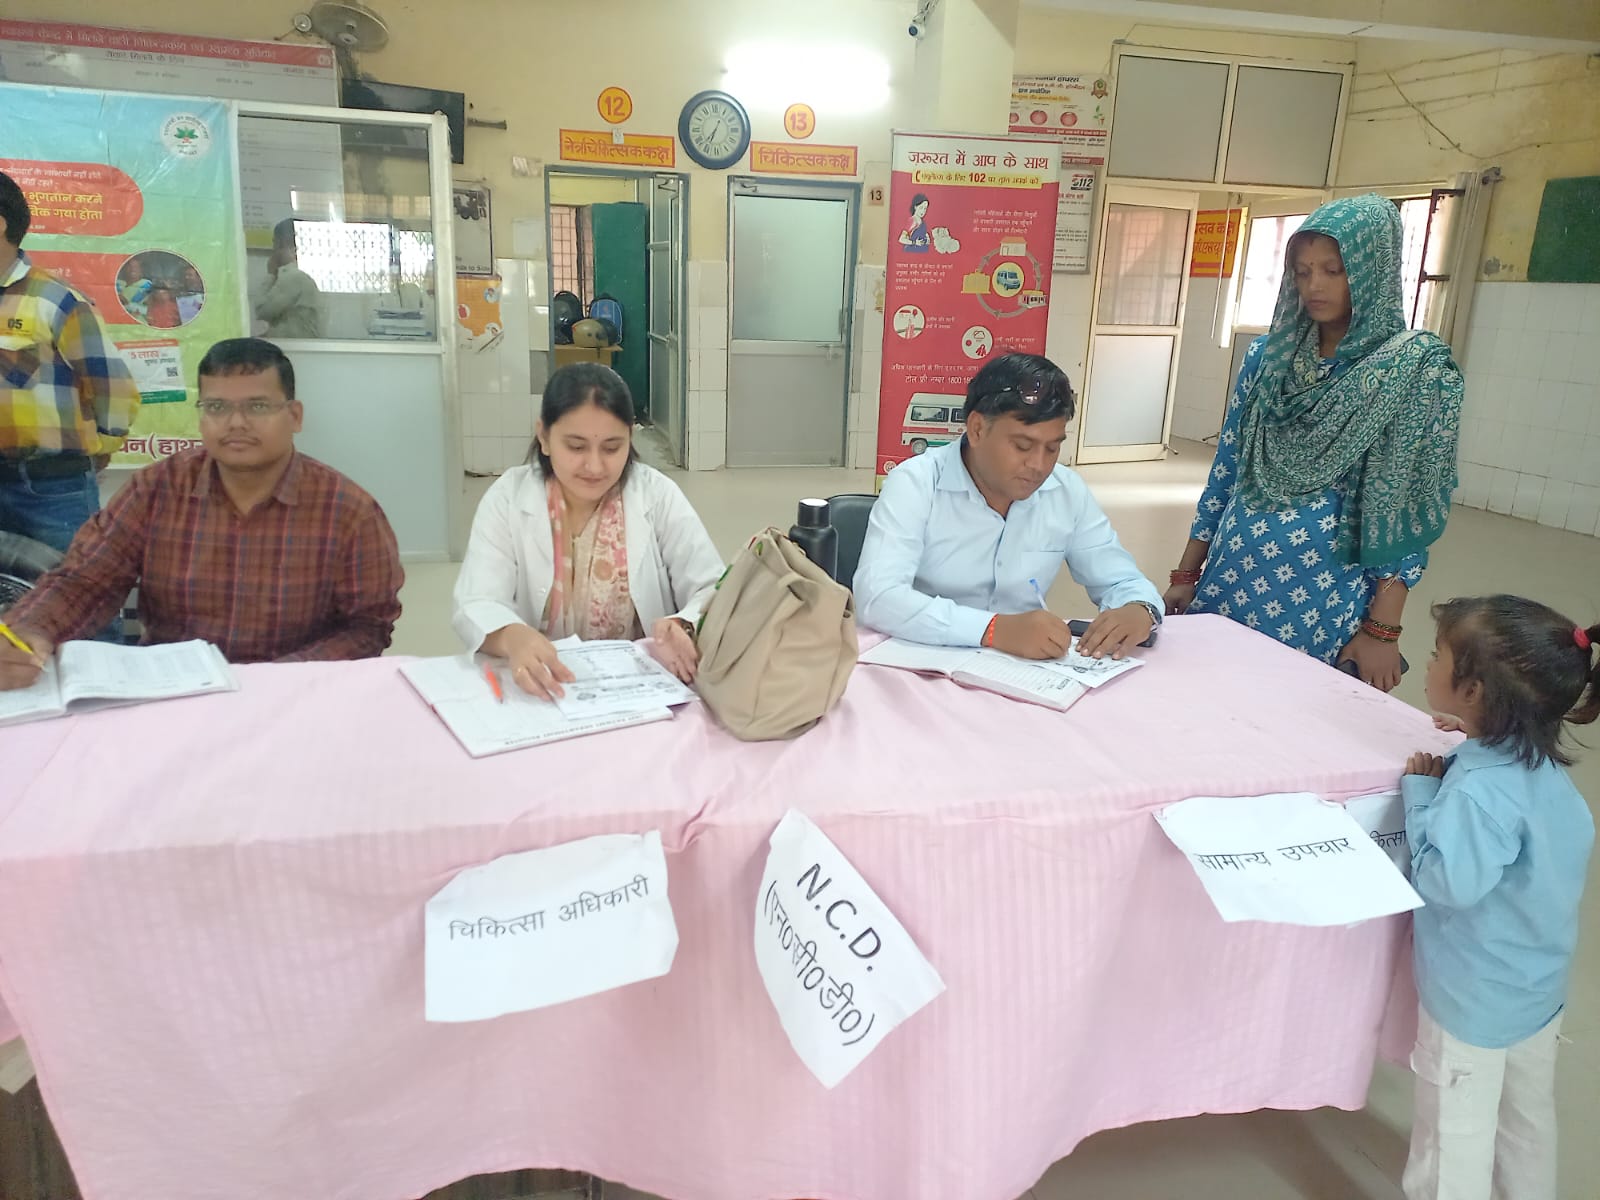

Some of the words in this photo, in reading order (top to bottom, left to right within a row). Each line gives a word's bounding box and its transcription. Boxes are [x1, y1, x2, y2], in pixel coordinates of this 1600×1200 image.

[602, 96, 625, 117] 12
[790, 111, 808, 132] 13
[955, 149, 966, 165] में
[972, 154, 997, 168] आप
[1003, 152, 1017, 168] के
[1023, 156, 1049, 169] साथ
[968, 172, 986, 183] 102
[74, 193, 103, 205] करने
[870, 190, 883, 201] 13
[54, 209, 77, 220] गया
[79, 207, 103, 220] होता
[905, 374, 917, 383] टोल
[1193, 851, 1272, 871] सामान्य
[1277, 837, 1356, 862] उपचार
[448, 908, 545, 942] चिकित्सा
[557, 873, 650, 924] अधिकारी
[797, 863, 882, 972] N.C.D.
